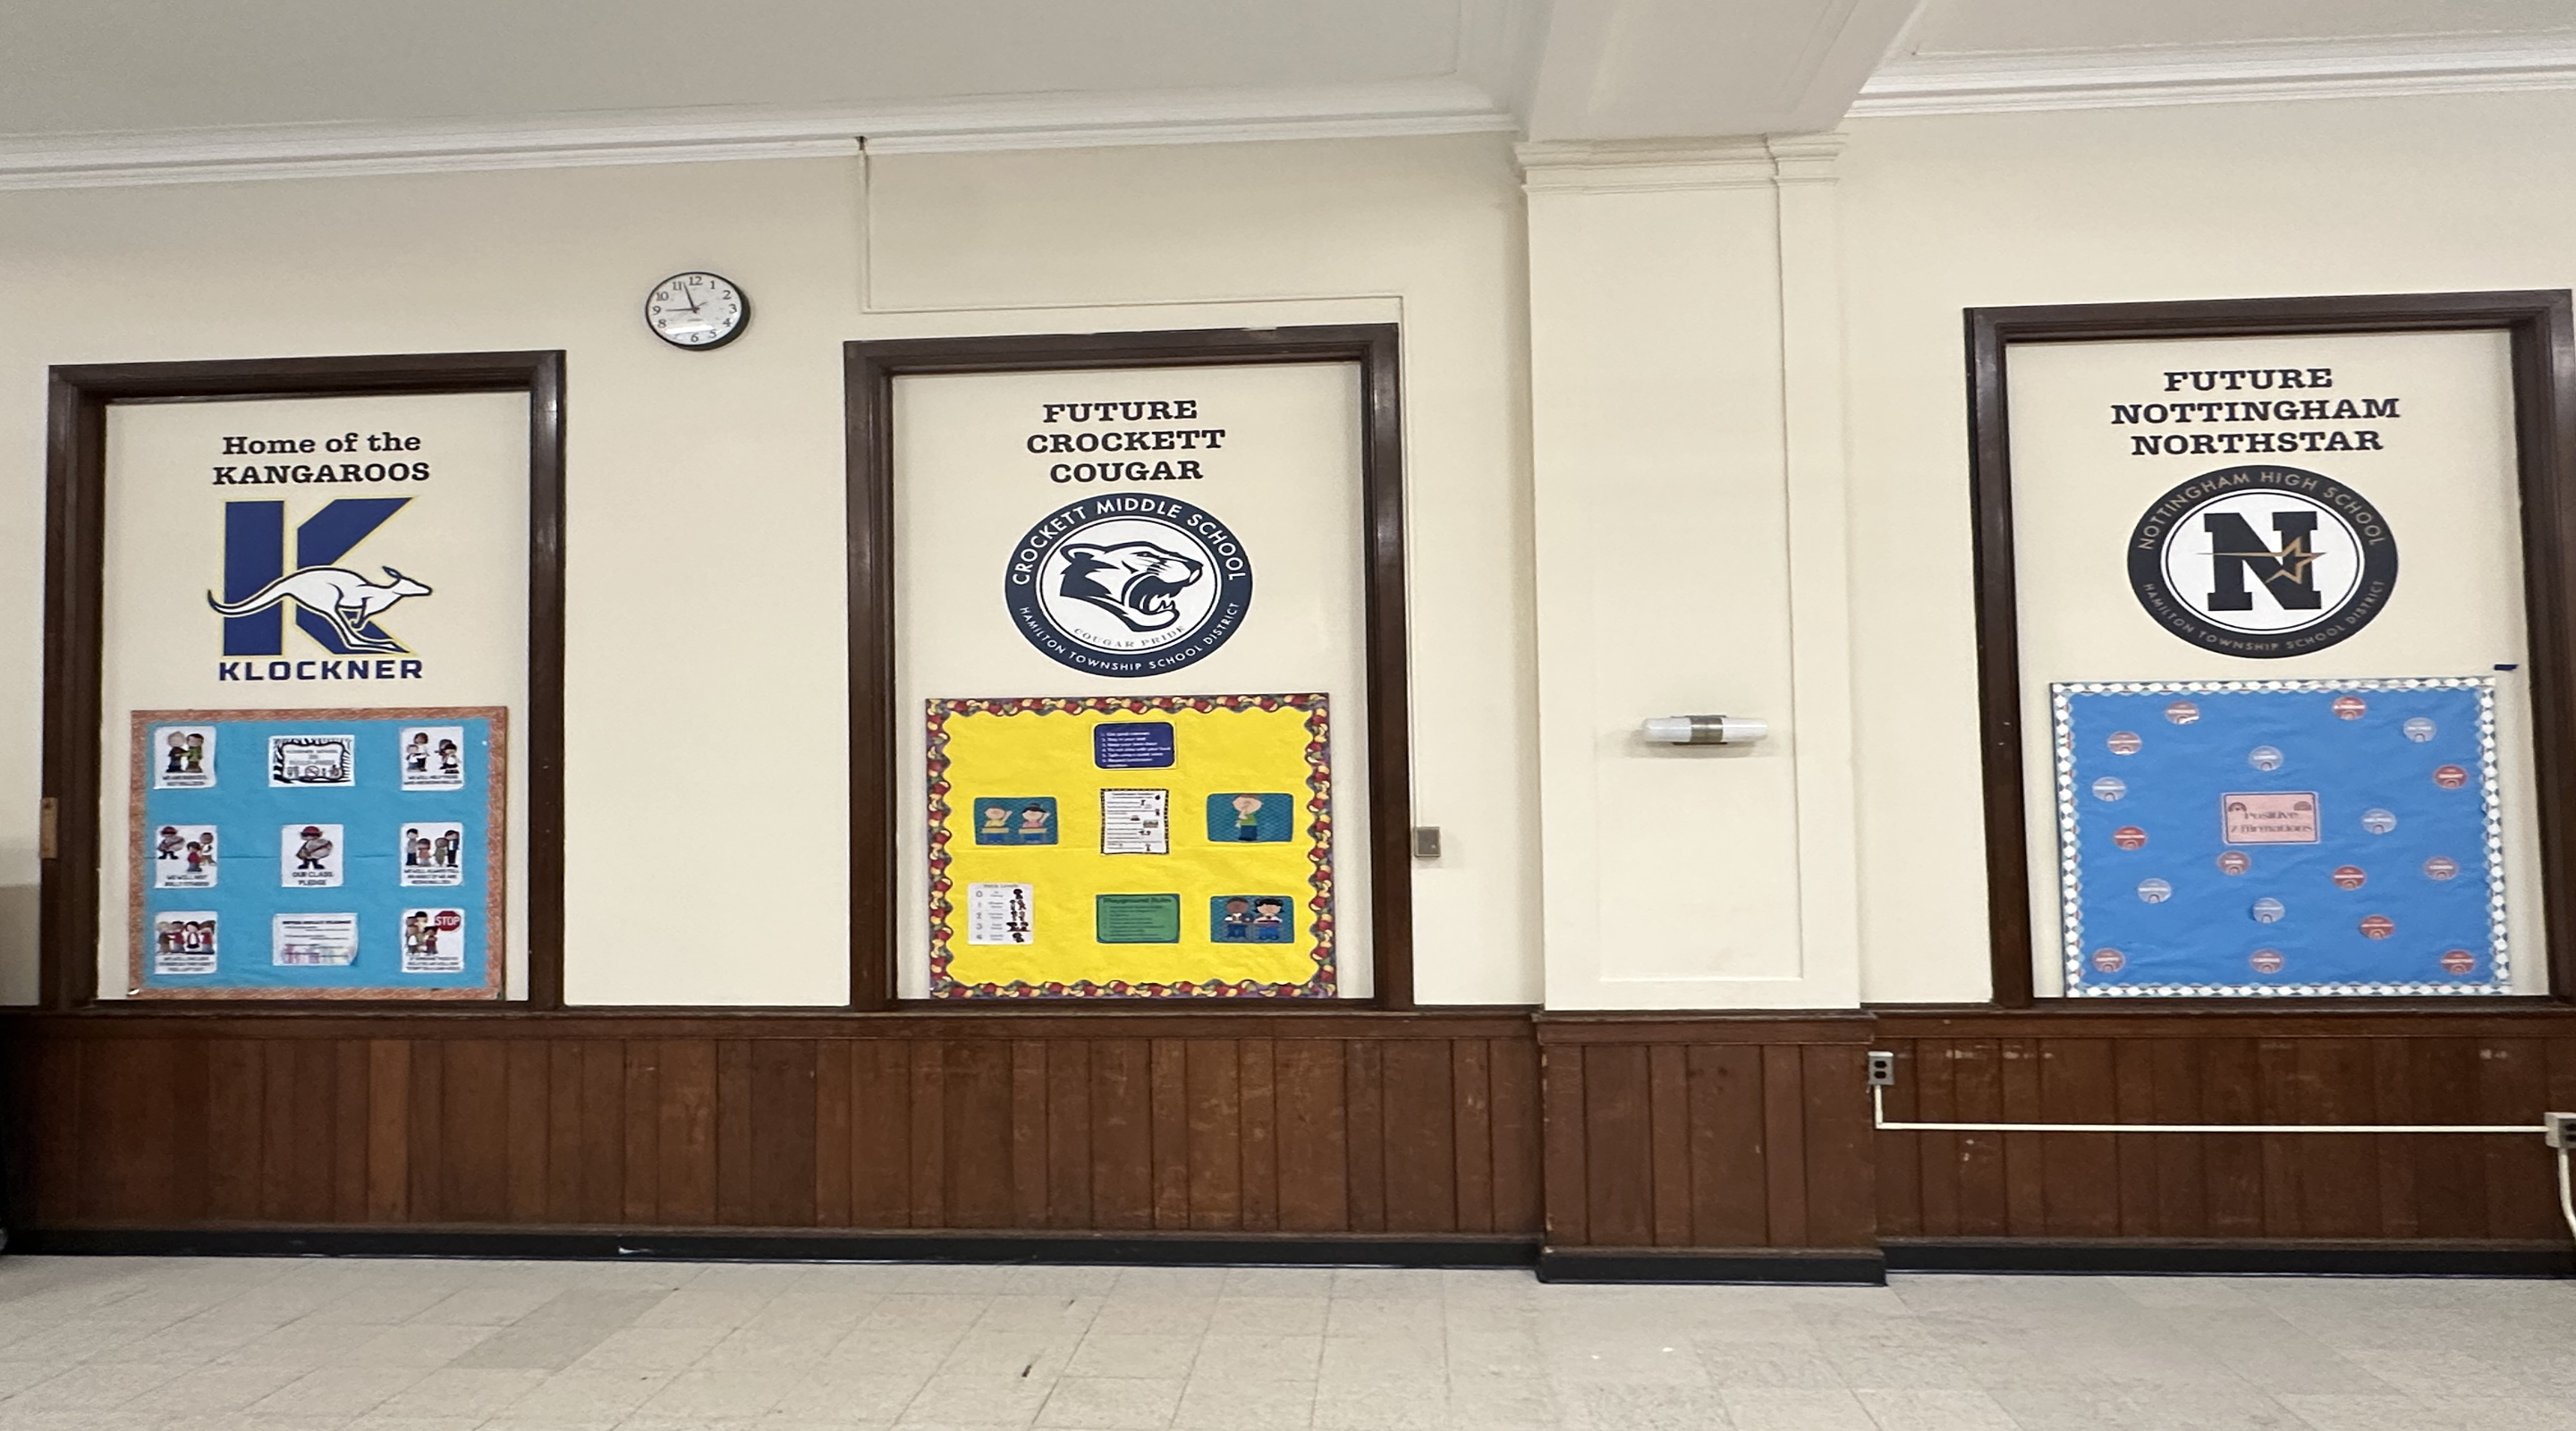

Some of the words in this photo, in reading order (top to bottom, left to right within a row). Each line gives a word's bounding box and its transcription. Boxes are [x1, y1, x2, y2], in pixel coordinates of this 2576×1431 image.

[672, 281, 682, 291] 11
[689, 275, 703, 286] 12
[710, 280, 716, 290] 1
[657, 291, 669, 301] 10
[722, 290, 732, 301] 2
[652, 305, 661, 315] 9
[729, 303, 738, 314] 3
[657, 318, 666, 328] 8
[708, 328, 716, 338] 5
[722, 318, 732, 327] 4
[691, 332, 699, 343] 6
[2165, 368, 2333, 392] FUTURE
[1043, 400, 1198, 423] FUTURE
[2111, 398, 2401, 425] NOTTINGHAM
[222, 436, 316, 455] Home
[326, 432, 359, 453] of
[367, 431, 421, 452] the
[1027, 429, 1225, 453] CROCKETT
[2131, 430, 2384, 456] NORTHSTAR
[212, 461, 430, 486] KANGAROOS
[1050, 460, 1204, 484] COUGAR
[2137, 472, 2250, 551] NOTTINGHAM
[2259, 470, 2319, 492] HIGH
[2324, 486, 2386, 546] SCHOOL
[1012, 505, 1088, 586] CROCKETT
[1096, 497, 1183, 519] MIDDLE
[1186, 513, 1247, 581] SCHOOL
[2203, 511, 2323, 612] N
[223, 497, 417, 657] K
[2142, 582, 2195, 634] HAMILTON
[2198, 630, 2280, 651] TOWNSHIP
[2285, 624, 2346, 650] SCHOOL
[2346, 580, 2385, 625] DISTRICT
[1019, 605, 1066, 655] HAMILTON
[1068, 650, 1143, 672] TOWNSHIP
[1148, 645, 1204, 670] SCHOOL
[1202, 602, 1241, 646] DISTRICT
[1073, 627, 1135, 648] COUGAR
[219, 659, 422, 682] KLOCKNER
[435, 916, 461, 927] STOP
